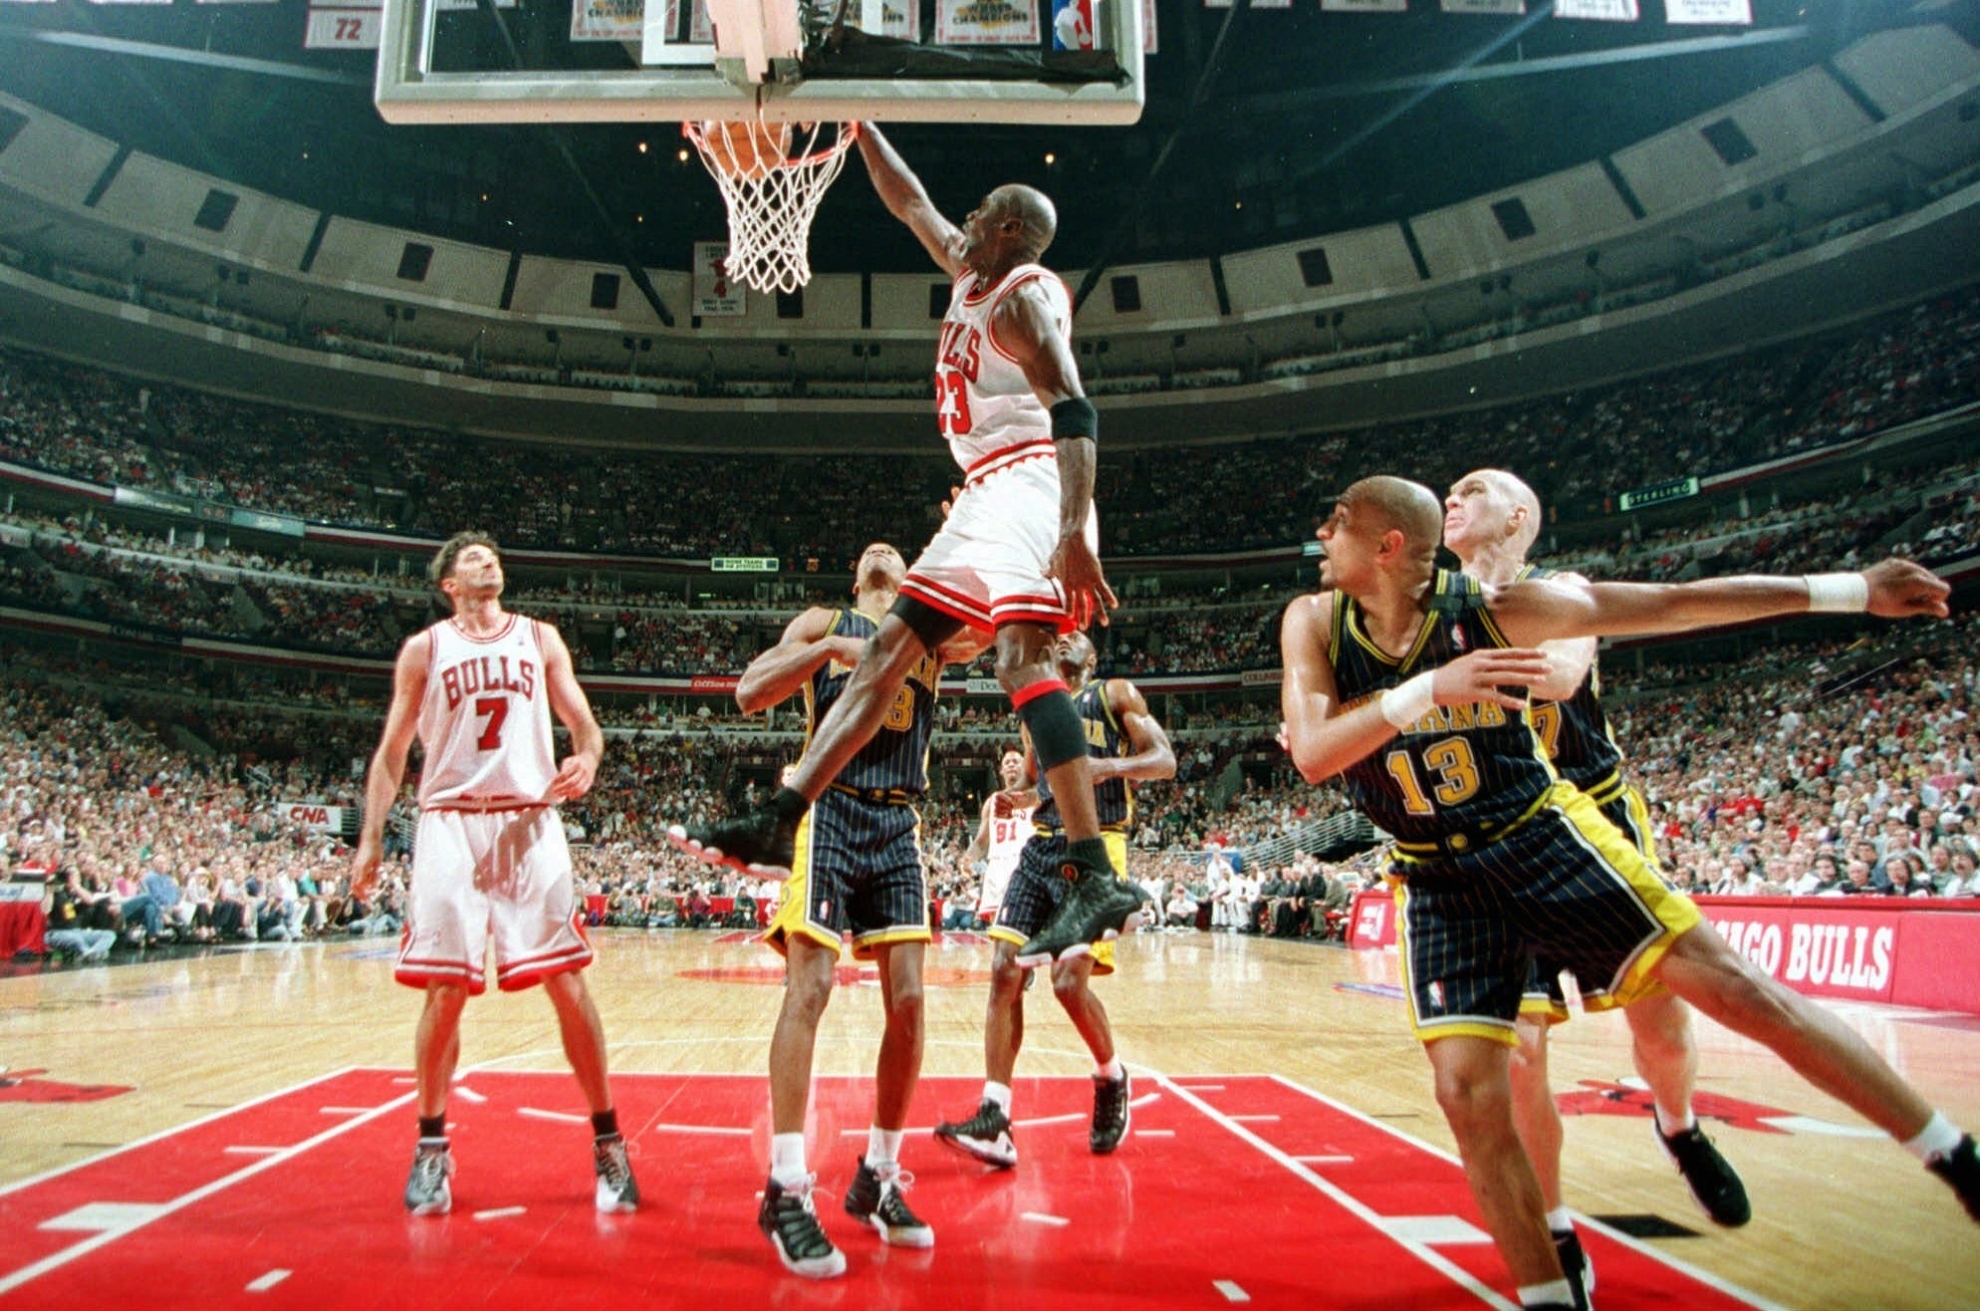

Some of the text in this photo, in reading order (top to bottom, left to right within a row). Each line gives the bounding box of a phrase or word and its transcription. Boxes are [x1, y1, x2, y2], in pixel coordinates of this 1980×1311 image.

[335, 18, 363, 40] 72
[442, 655, 534, 711] BULLS
[475, 697, 509, 751] 7
[1386, 735, 1481, 816] 13
[290, 806, 329, 825] CNA
[996, 821, 1017, 844] 91
[1786, 923, 1893, 991] BULLS
